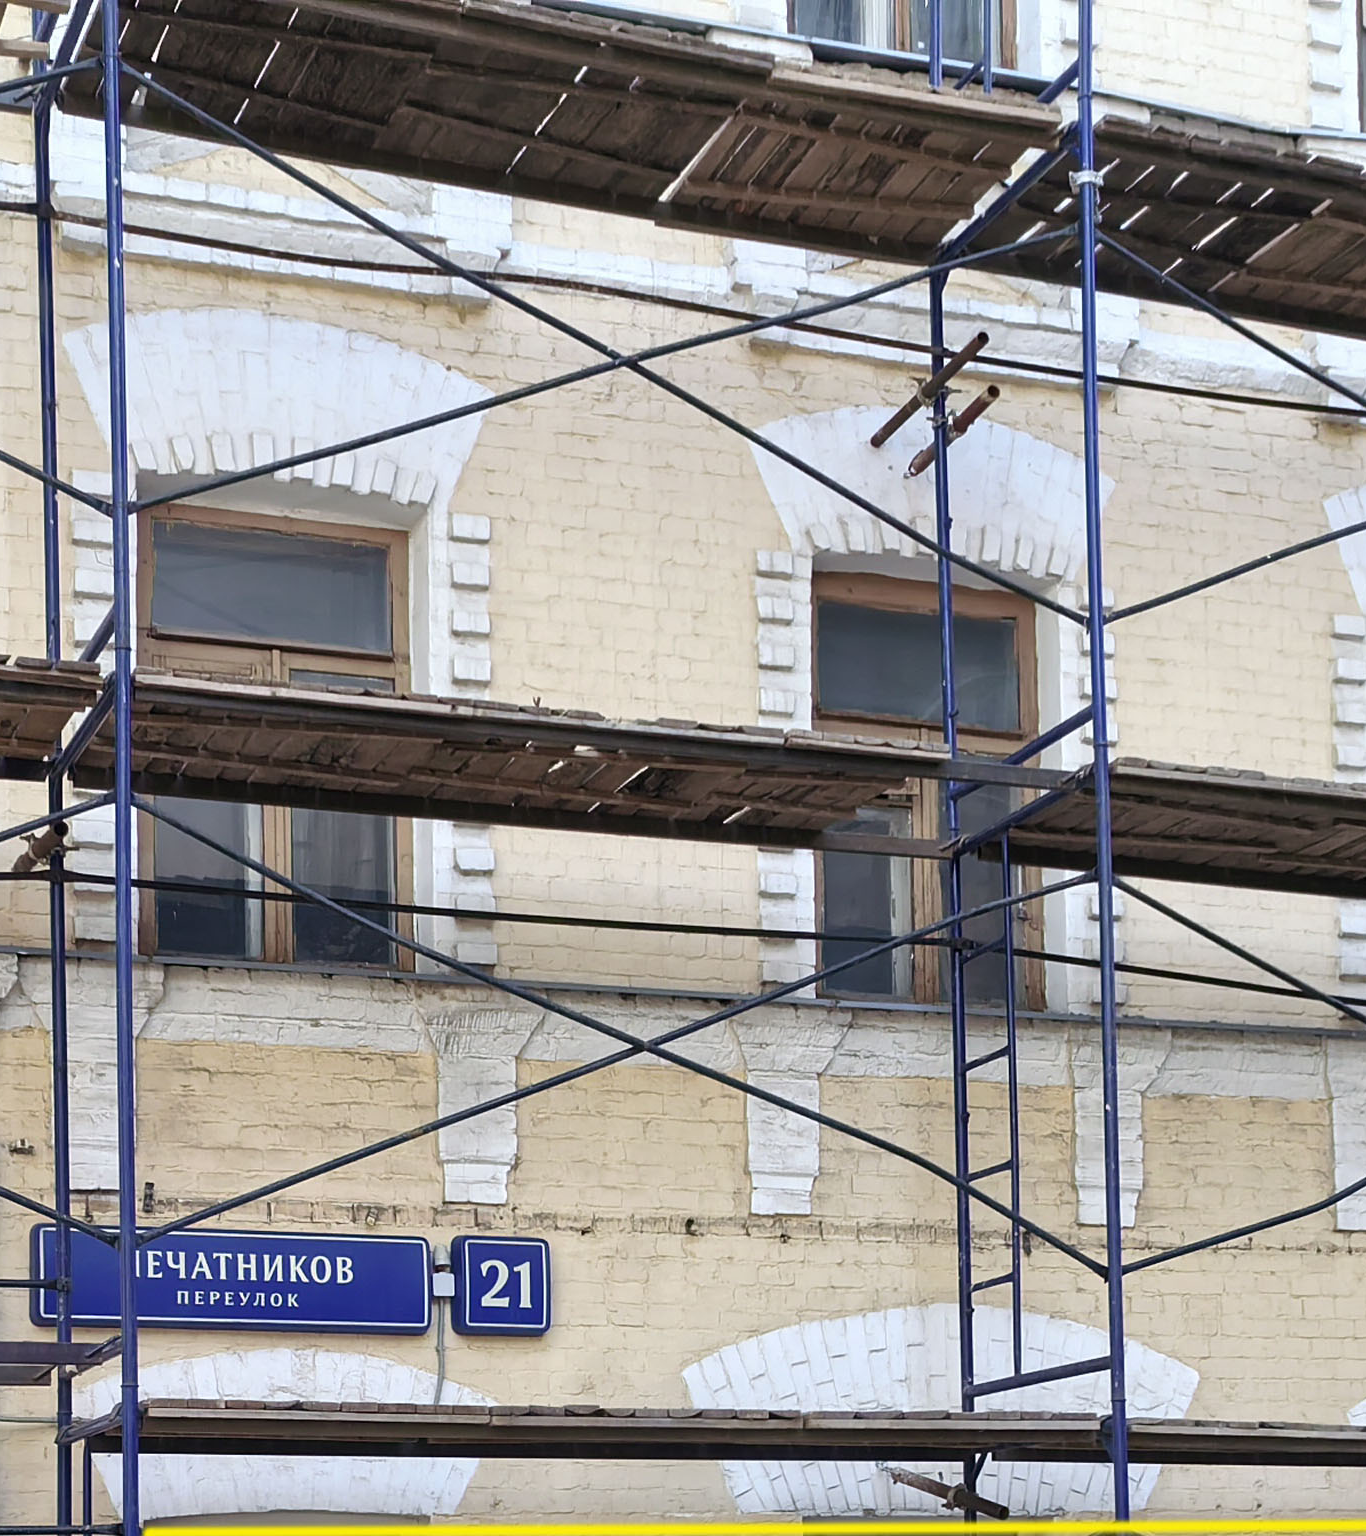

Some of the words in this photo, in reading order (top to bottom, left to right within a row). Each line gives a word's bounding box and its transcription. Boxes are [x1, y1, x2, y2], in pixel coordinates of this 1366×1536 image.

[135, 1250, 354, 1284] ЕЧАТНИКОВ
[480, 1259, 532, 1309] 21
[176, 1290, 300, 1308] ПЕРЕУЛОК
